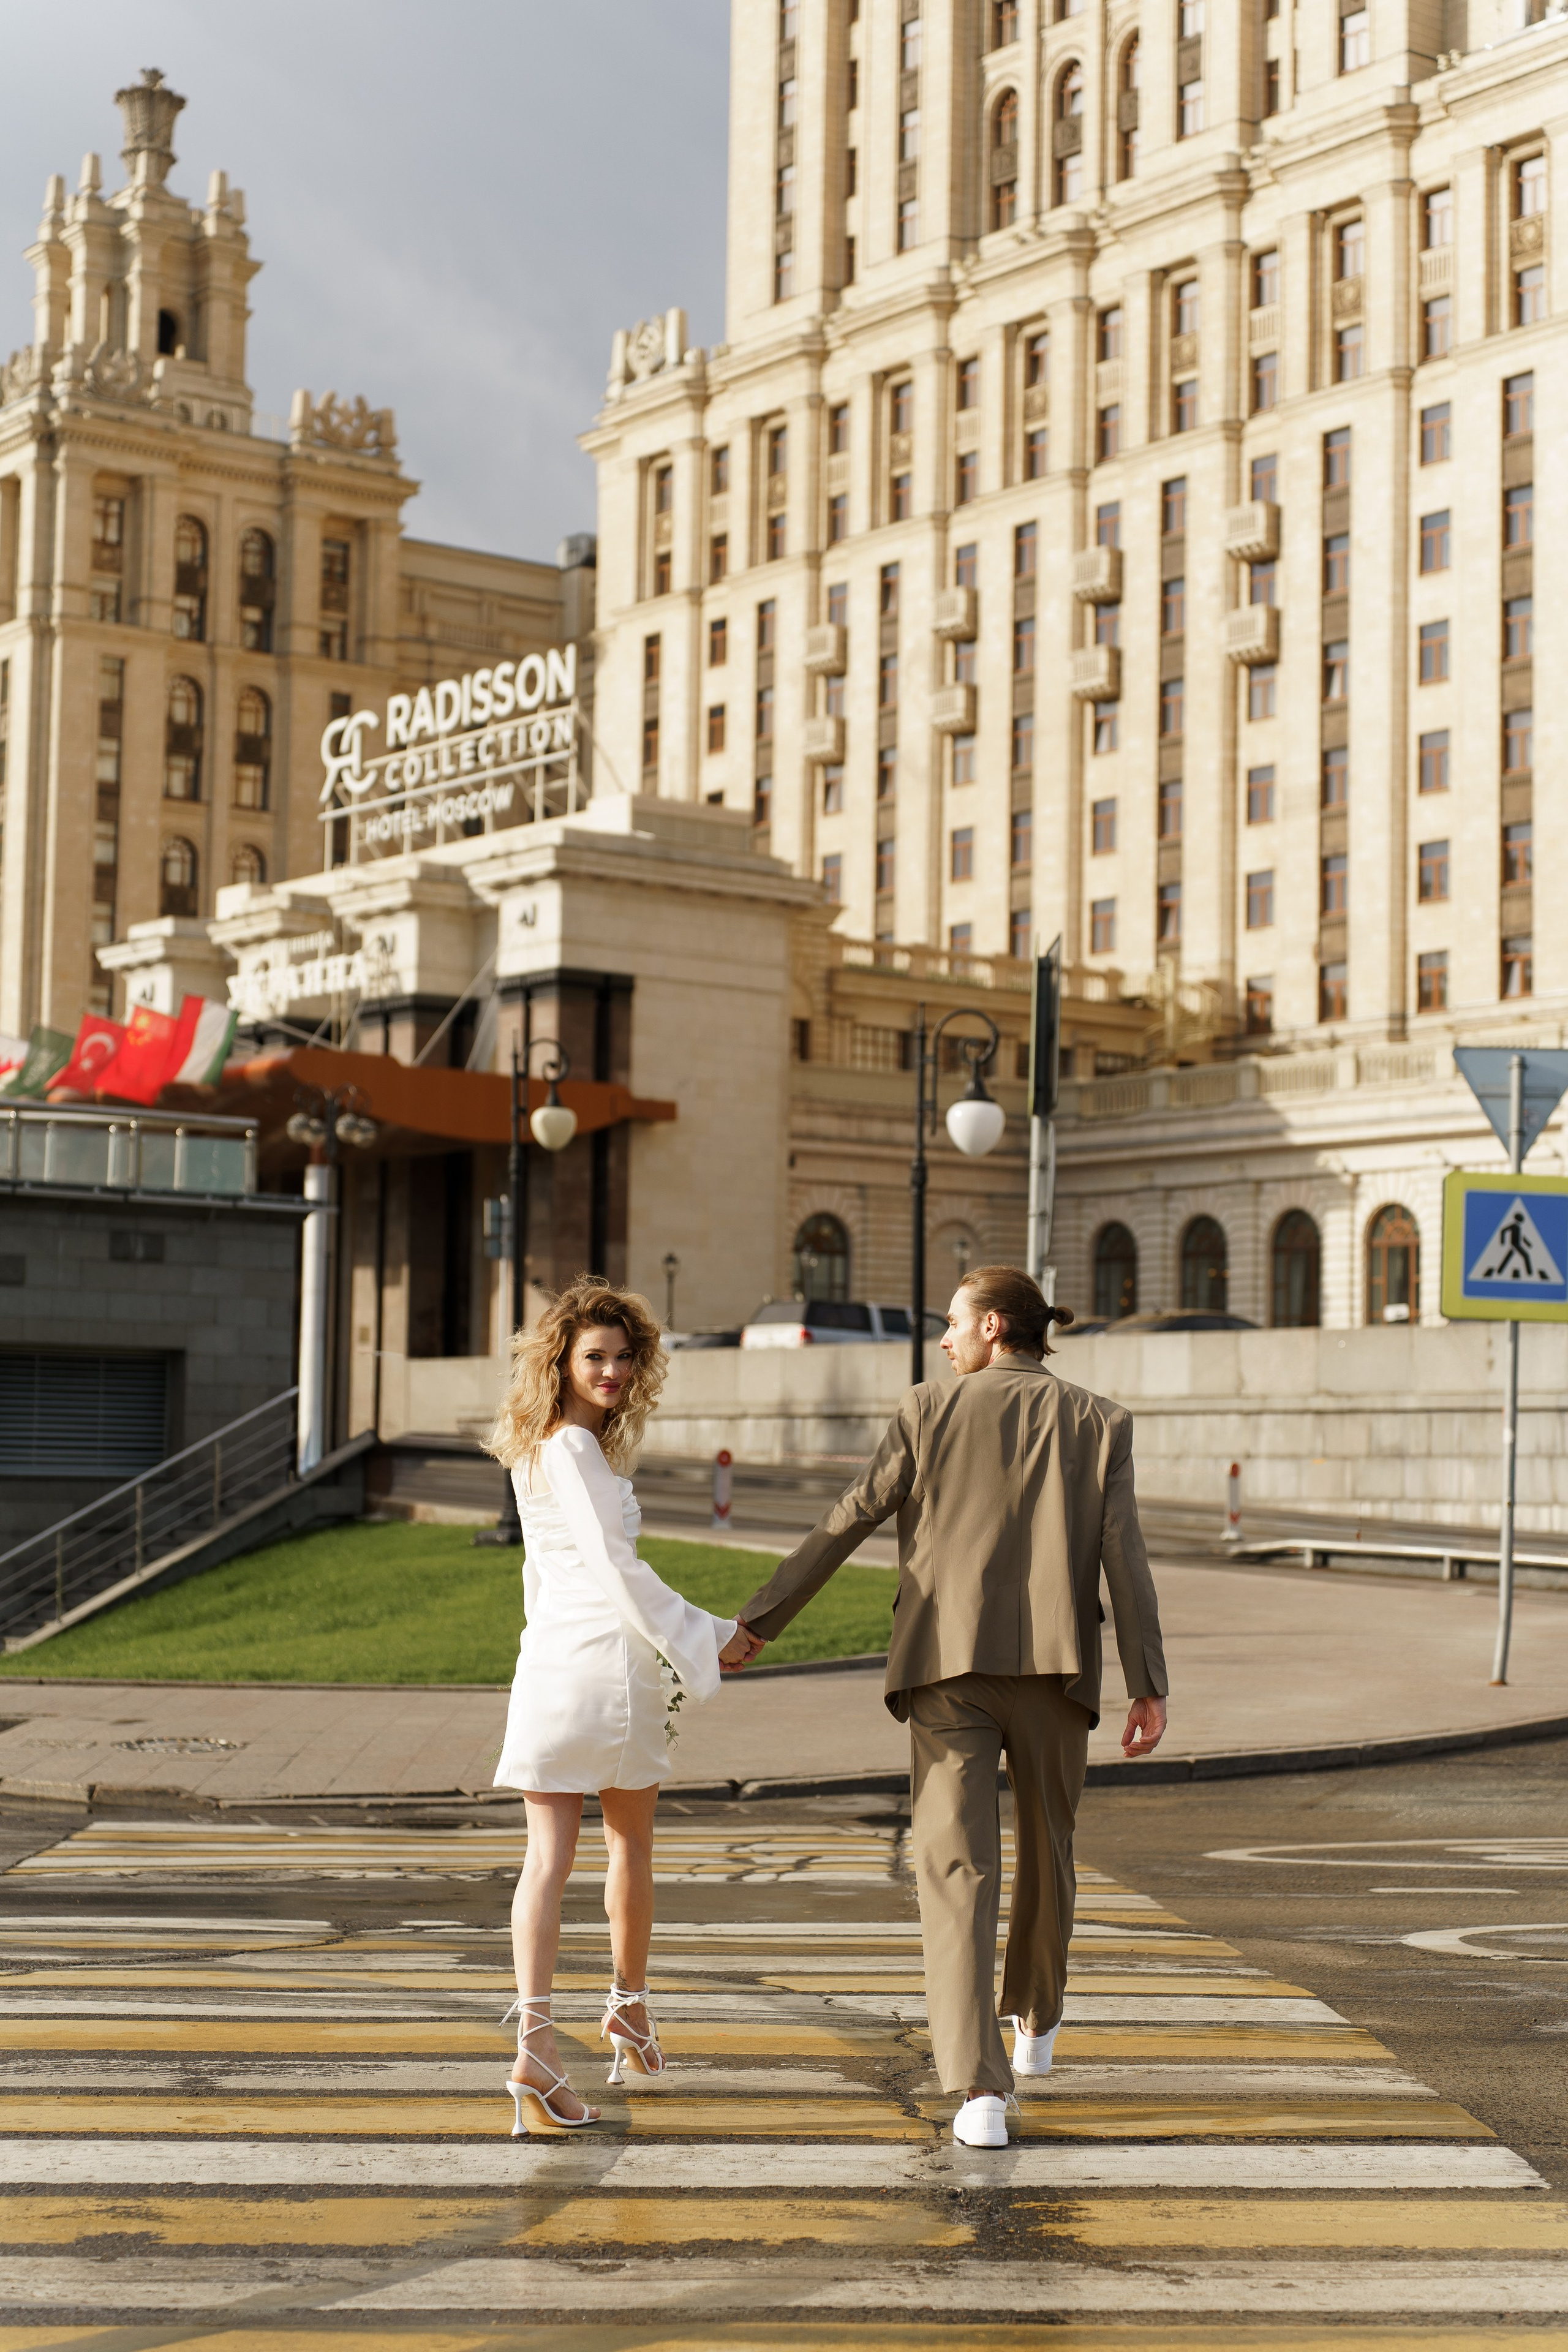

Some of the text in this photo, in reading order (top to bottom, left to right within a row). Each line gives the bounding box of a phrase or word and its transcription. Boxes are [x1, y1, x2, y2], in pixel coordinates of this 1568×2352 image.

[386, 642, 577, 749] RADISSON
[384, 713, 574, 791] COLLECTION
[365, 782, 516, 844] HOTEL MOSCOW
